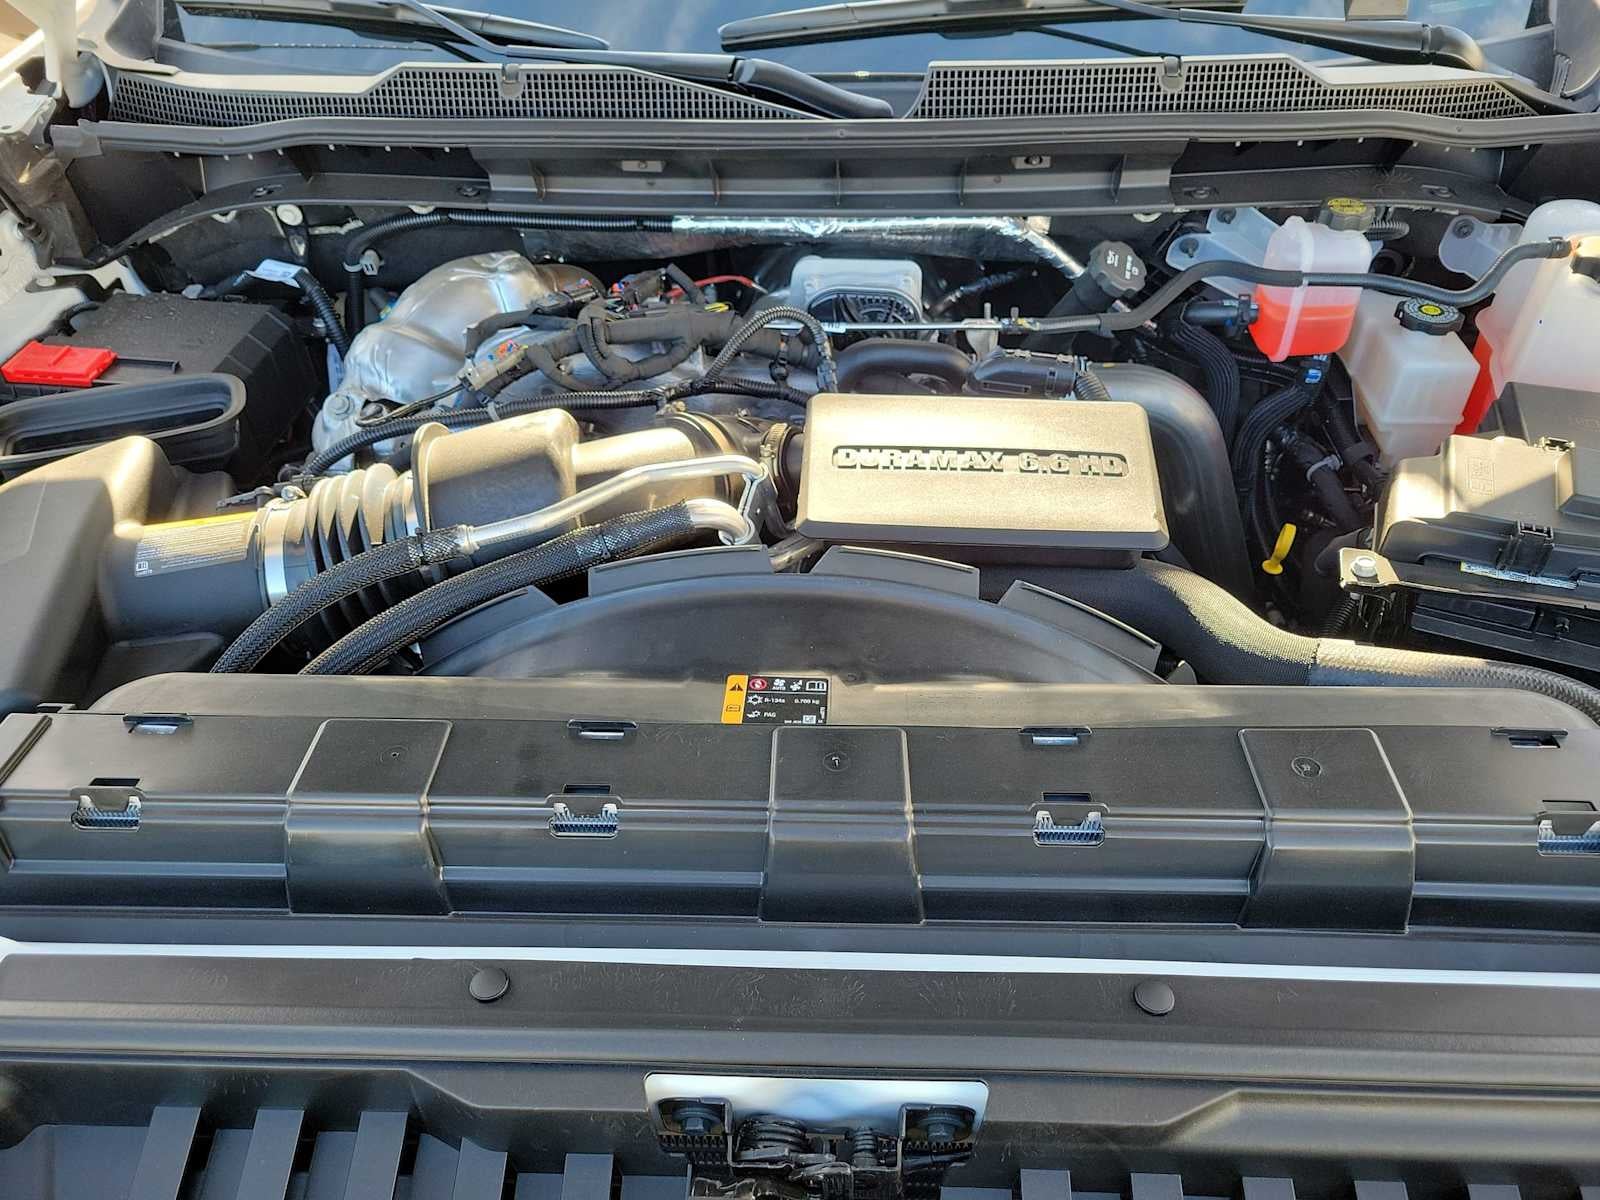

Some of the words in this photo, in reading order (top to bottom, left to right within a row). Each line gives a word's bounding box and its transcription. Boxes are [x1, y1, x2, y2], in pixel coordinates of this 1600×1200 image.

[835, 448, 1004, 472] DURAMAX
[1018, 452, 1071, 475] 6.6
[1078, 454, 1124, 477] HD
